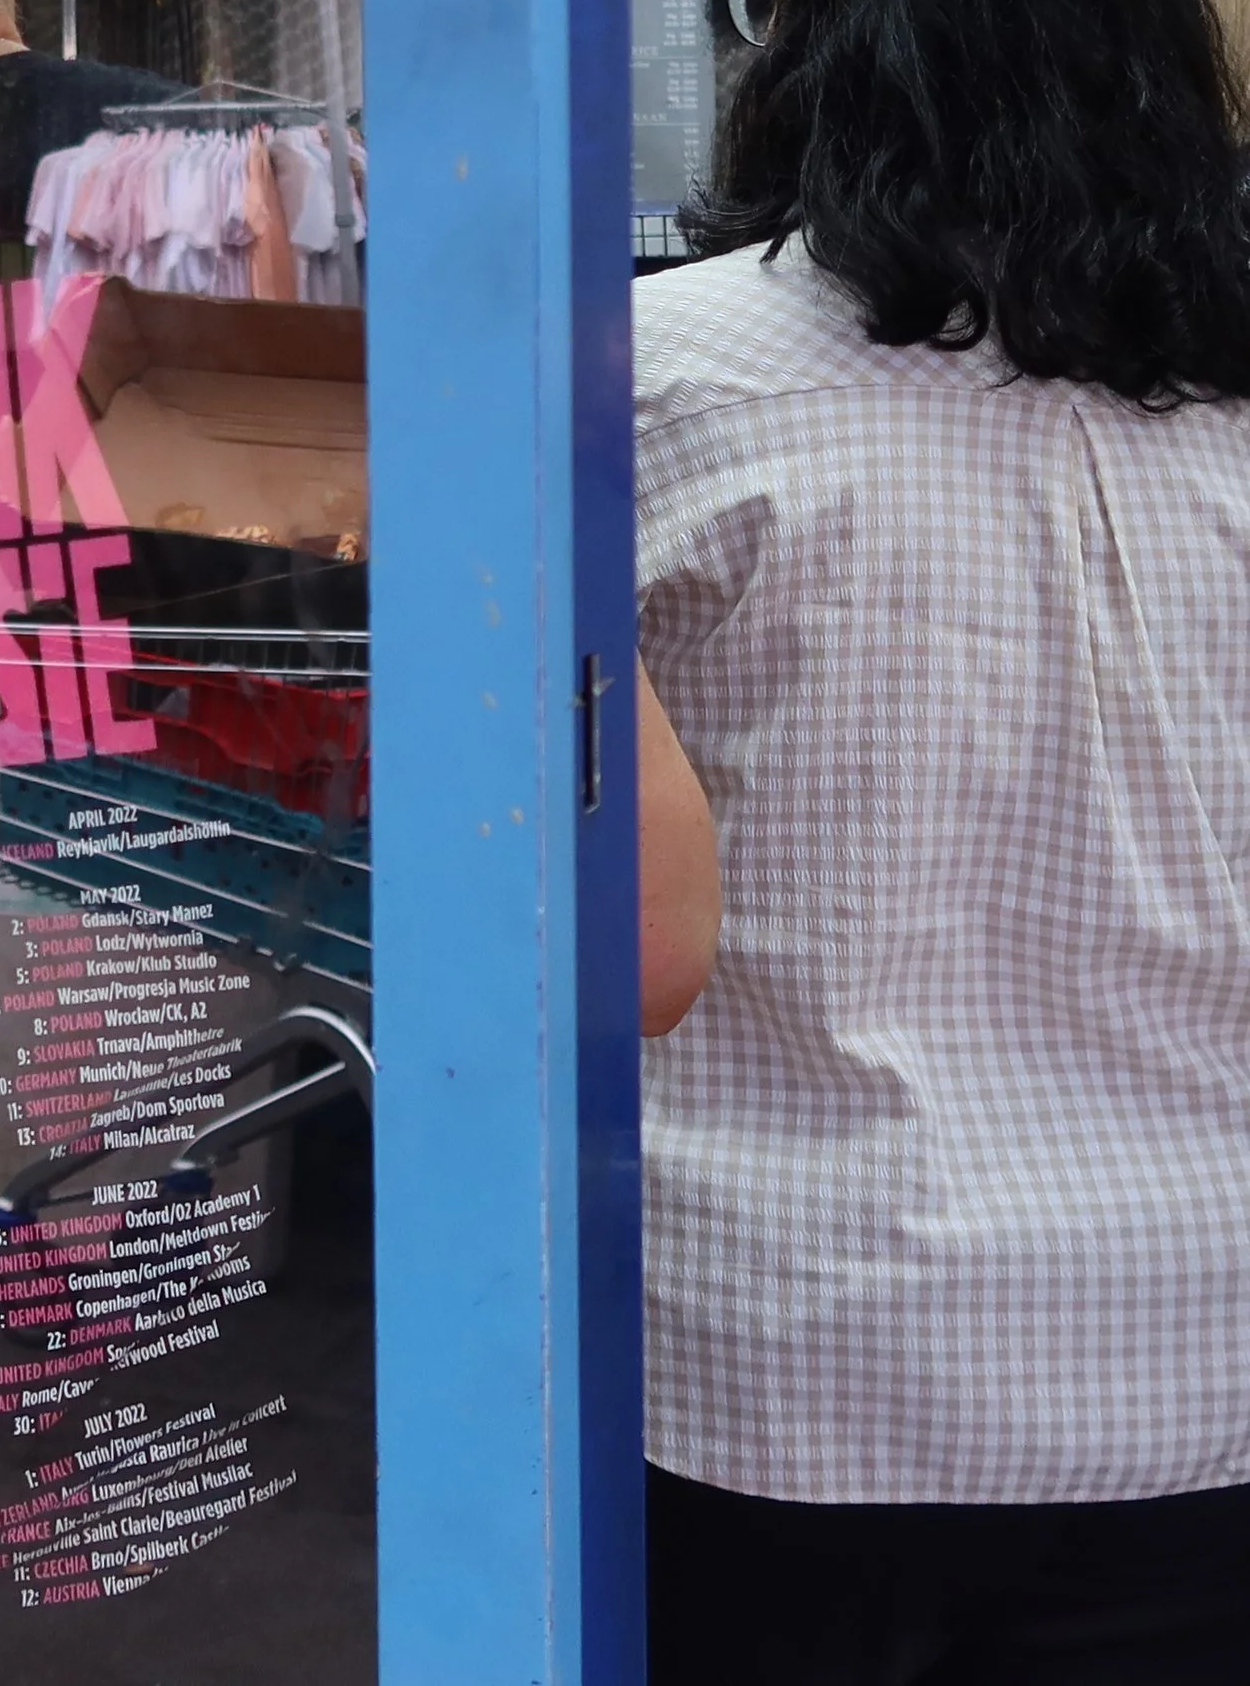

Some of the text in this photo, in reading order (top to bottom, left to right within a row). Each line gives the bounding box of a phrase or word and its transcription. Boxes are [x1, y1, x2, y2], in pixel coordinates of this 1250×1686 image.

[68, 806, 138, 830] APRIL 2022
[80, 884, 141, 905] MAY 2022
[26, 930, 204, 958] 3: POLAND Lodz/Wytwornia
[34, 1002, 207, 1036] 8: POLAND Wroclaw/CK, A2
[92, 1181, 158, 1206] JUNE 2022
[10, 1219, 57, 1244] UNITED
[61, 1213, 122, 1238] KINGDOM
[194, 1189, 250, 1217] Academy
[84, 1403, 147, 1439] JULY 2022
[14, 1536, 189, 1581] 11: CZECHIA Brno/Spilberk
[21, 1581, 100, 1607] 12: AUSTRIA
